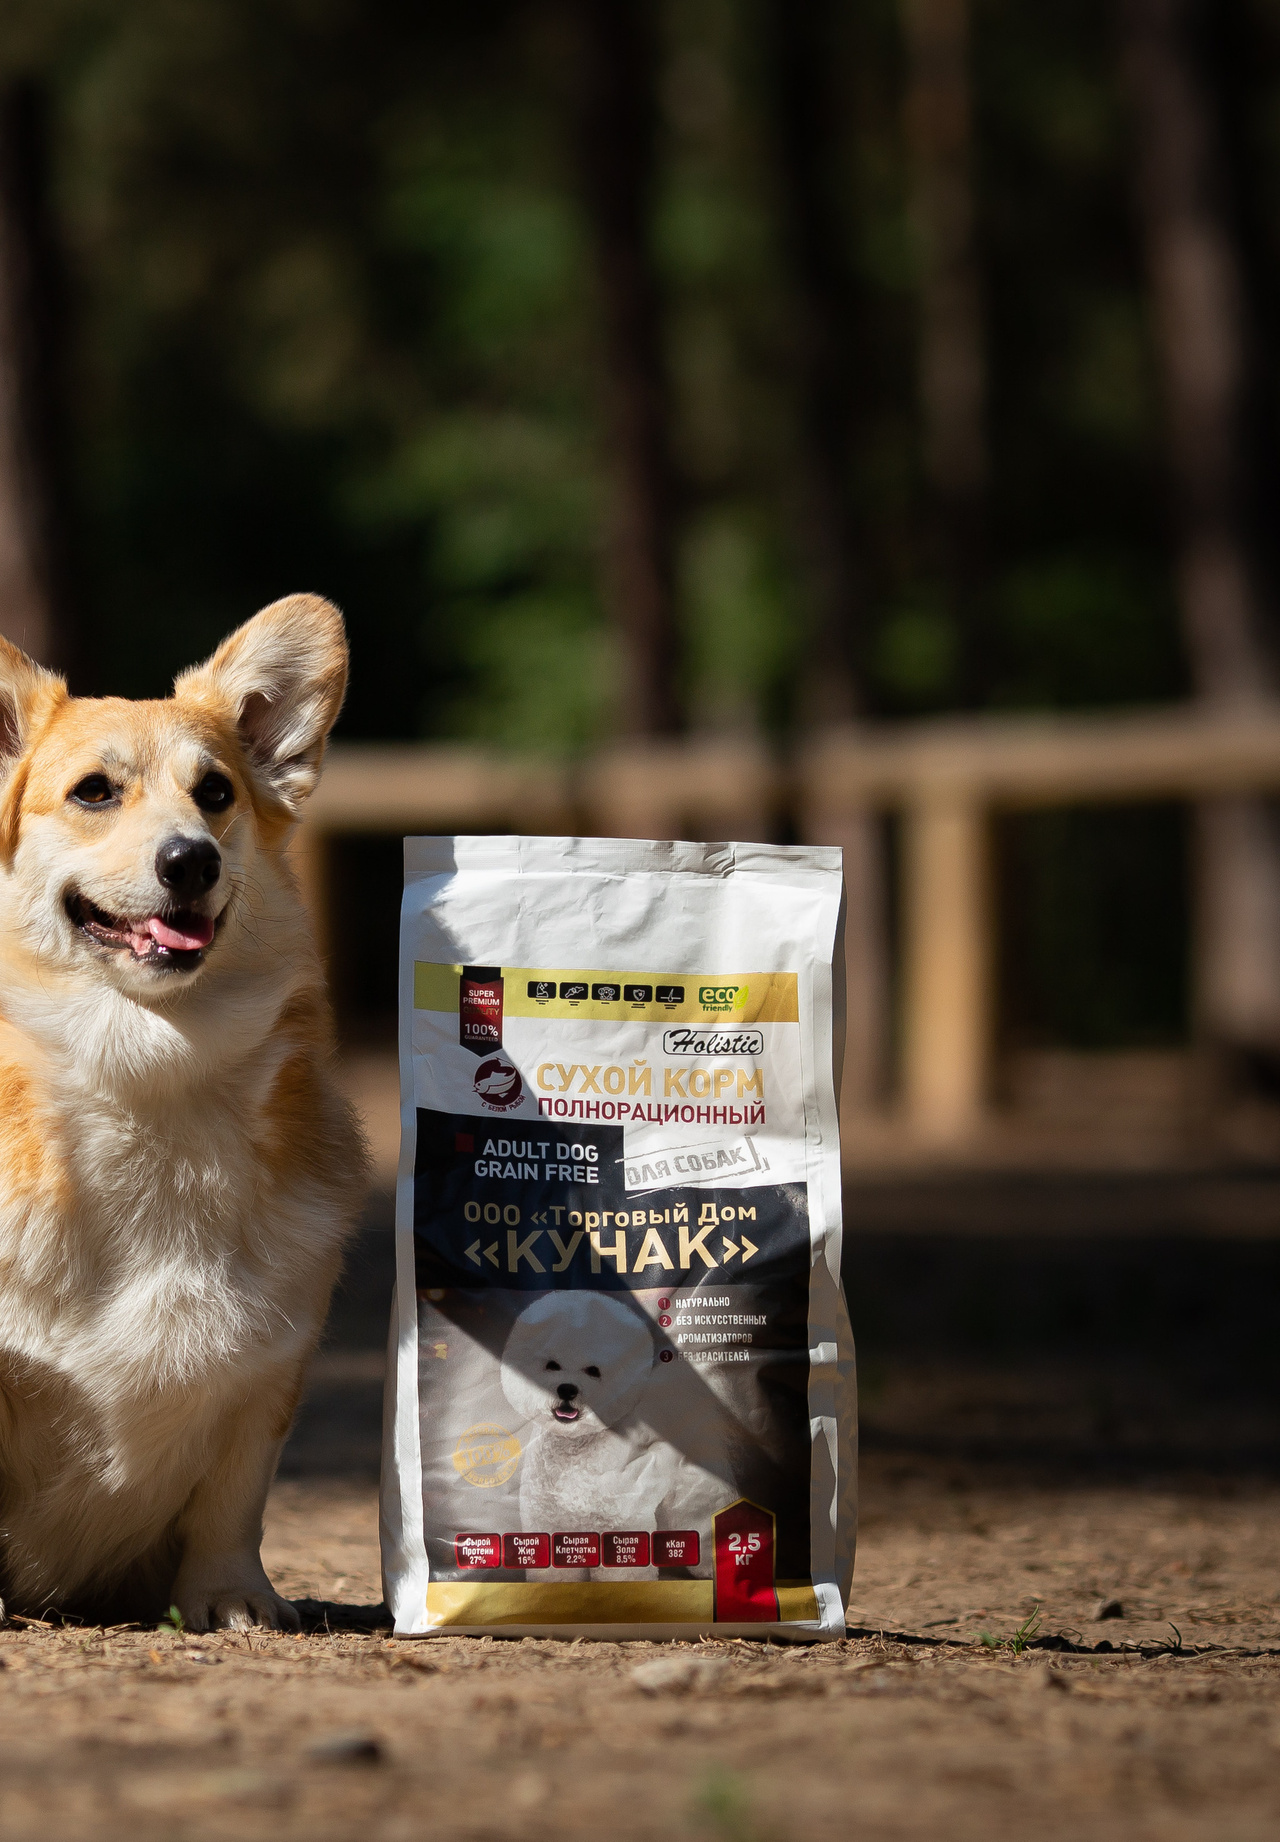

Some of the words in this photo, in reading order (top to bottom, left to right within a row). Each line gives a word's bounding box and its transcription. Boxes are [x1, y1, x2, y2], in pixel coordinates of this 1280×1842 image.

[468, 989, 494, 998] SUPER
[702, 988, 735, 1002] eco
[462, 997, 500, 1006] PREMIUM
[464, 1006, 500, 1016] QUALITY
[702, 1004, 732, 1012] friendly
[464, 1023, 499, 1037] 100%
[670, 1028, 760, 1054] Holistic
[536, 1059, 652, 1096] СУХОЙ
[663, 1068, 764, 1099] КОРМ
[538, 1097, 766, 1125] ПОЛНОРАЦИОННЫЙ
[482, 1139, 550, 1160] ADULT
[556, 1142, 599, 1163] DOG
[674, 1147, 747, 1172] СОБАК
[474, 1159, 538, 1180] GRAIN
[545, 1164, 600, 1184] FREE
[463, 1201, 521, 1226] ООО
[530, 1202, 689, 1232] «Торговый
[697, 1202, 757, 1226] Дом
[464, 1225, 759, 1274] «КУНАК»
[676, 1297, 730, 1309] НАТУРАЛЬНО
[676, 1316, 692, 1325] БЕЗ
[694, 1315, 767, 1325] ИСКУССТВЕННЫХ
[677, 1333, 752, 1344] АРОМАТИЗАТОРОВ
[695, 1349, 750, 1361] КРАСИТЕЛЕЙ
[461, 1443, 511, 1466] 100%
[466, 1538, 491, 1547] Сырой
[513, 1537, 540, 1547] Сырой
[562, 1536, 589, 1546] Сырая
[613, 1536, 639, 1546] Сырая
[666, 1540, 686, 1549] кКал
[728, 1533, 761, 1553] 2,5
[462, 1547, 494, 1557] Протеин
[517, 1547, 536, 1557] Жир
[555, 1546, 597, 1555] Клетчатка
[616, 1546, 636, 1555] Зола
[668, 1549, 683, 1558] 382
[469, 1556, 486, 1565] 27%
[517, 1556, 536, 1565] 16%
[566, 1555, 586, 1564] 2,2%
[616, 1554, 636, 1563] 8,5%
